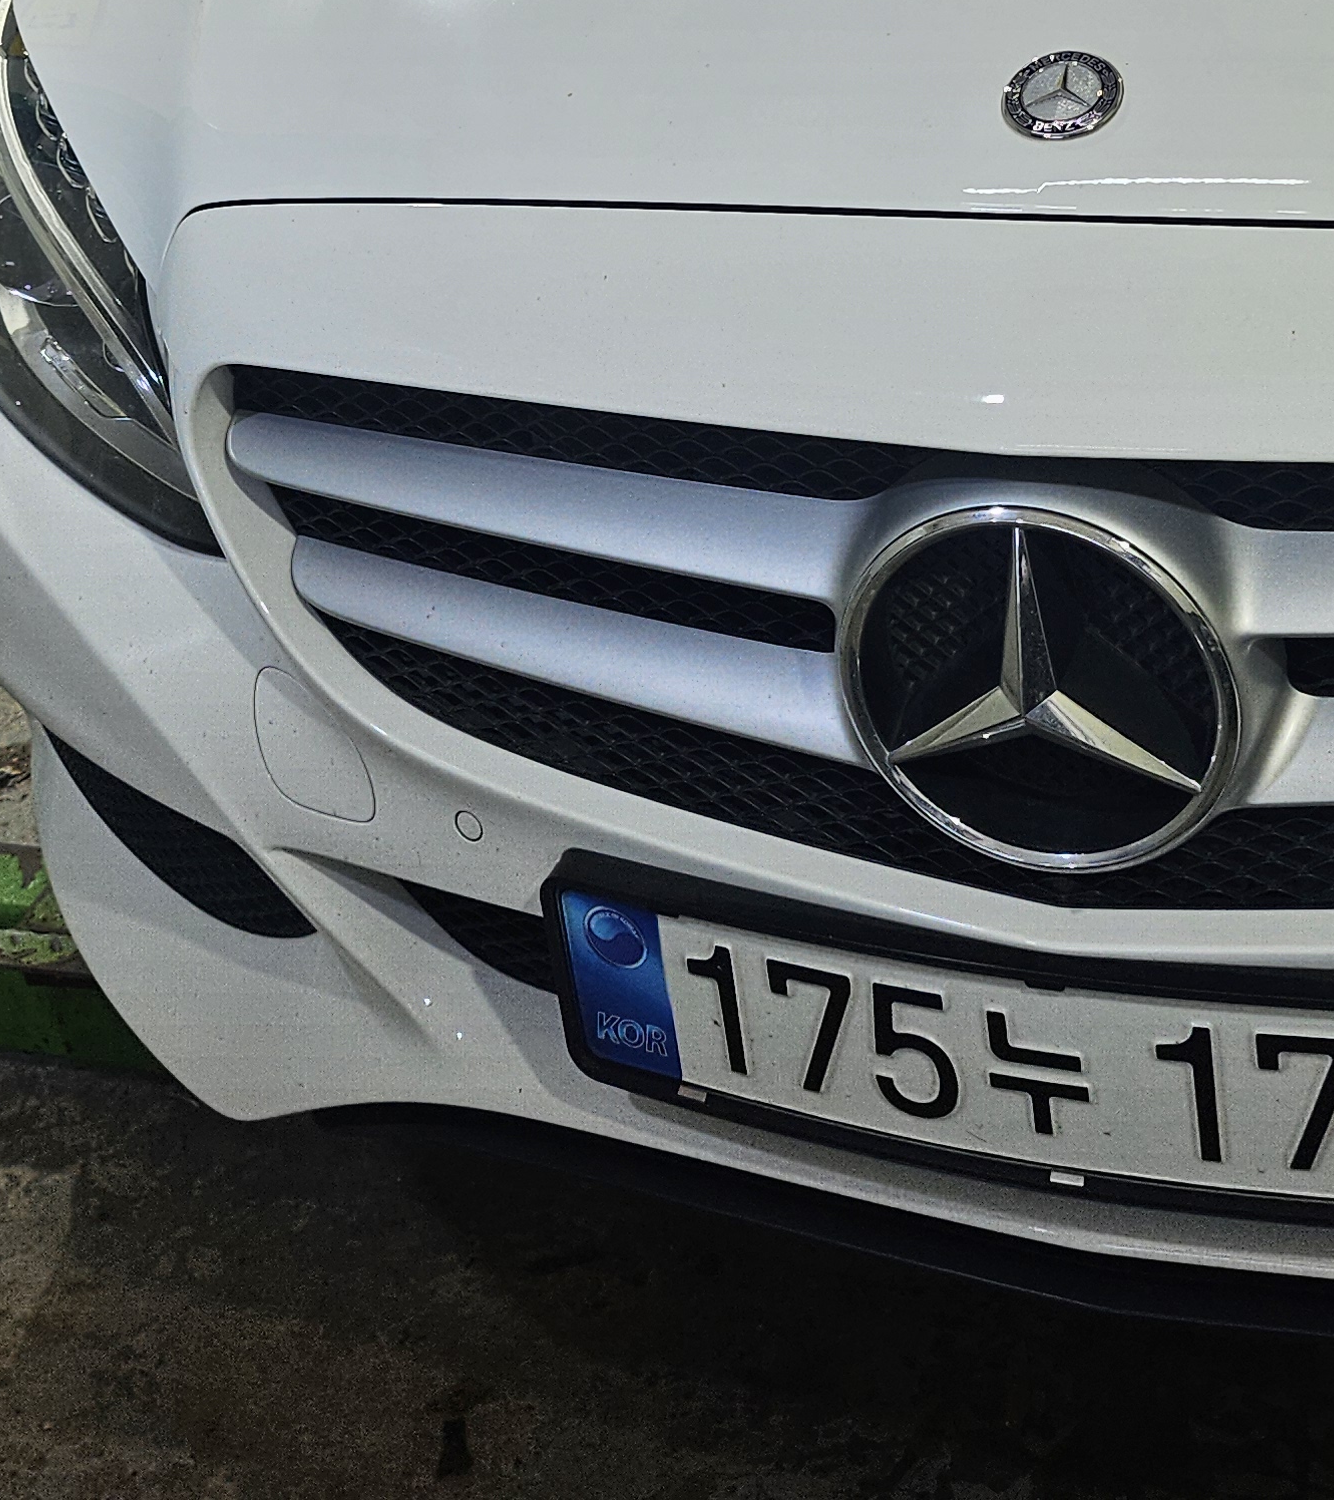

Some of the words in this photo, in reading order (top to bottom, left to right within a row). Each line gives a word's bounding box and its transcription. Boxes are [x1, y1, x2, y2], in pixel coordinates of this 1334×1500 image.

[1029, 51, 1106, 72] MERCEDES
[1032, 119, 1076, 132] BENZ
[597, 1011, 668, 1057] KOR
[685, 944, 1091, 1137] 175누
